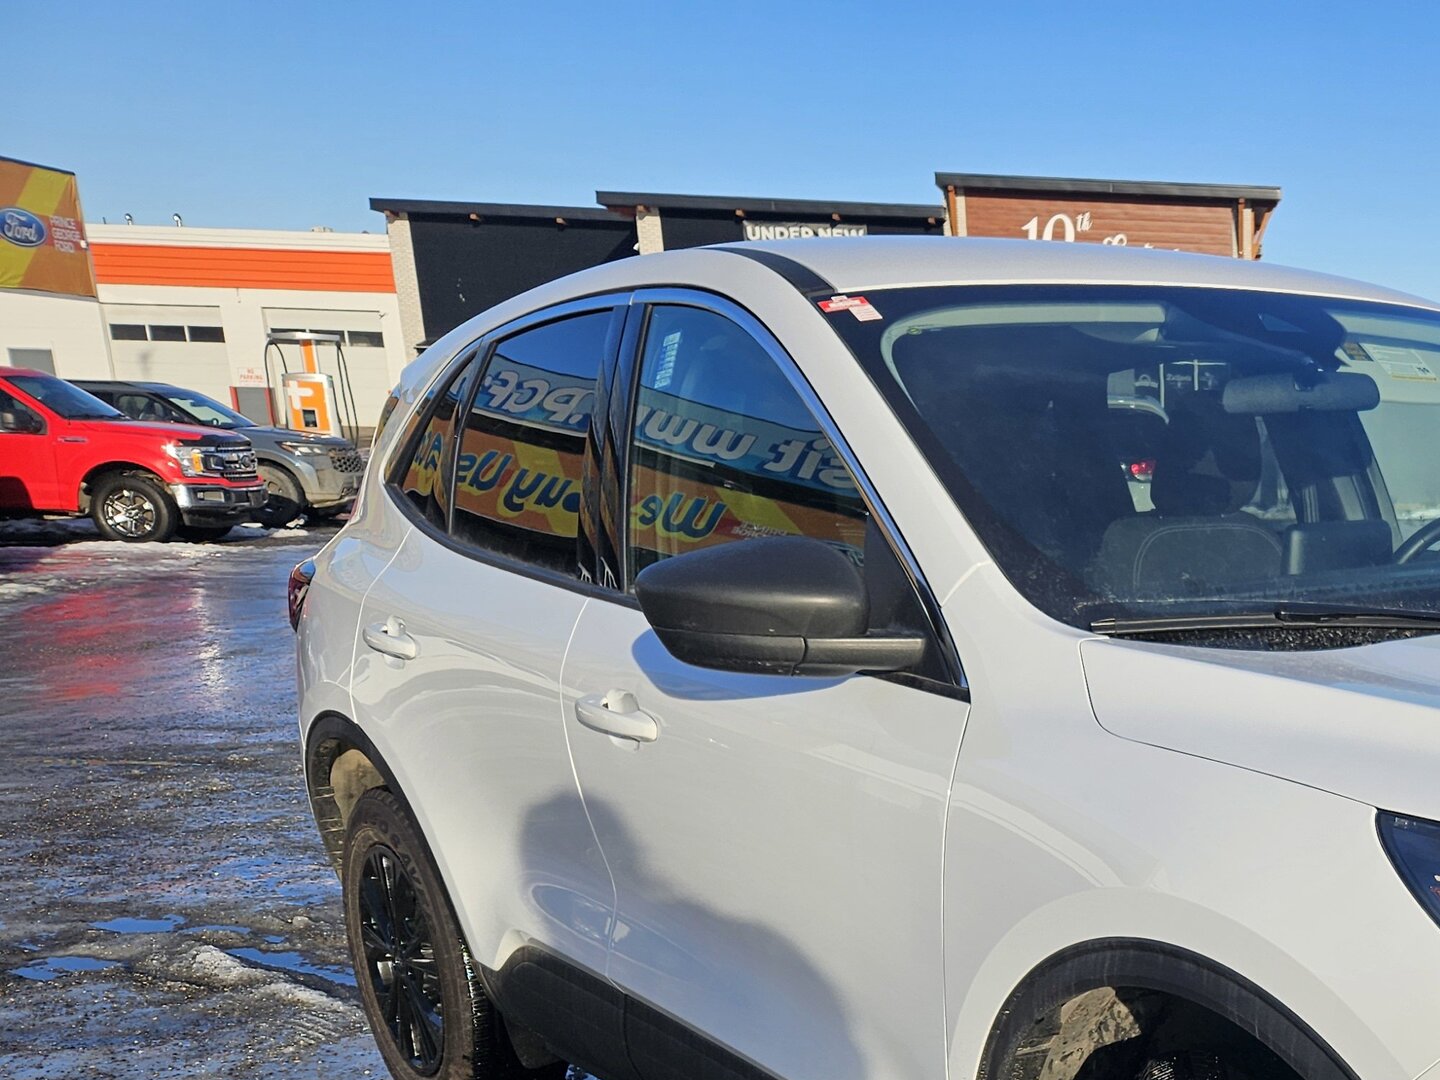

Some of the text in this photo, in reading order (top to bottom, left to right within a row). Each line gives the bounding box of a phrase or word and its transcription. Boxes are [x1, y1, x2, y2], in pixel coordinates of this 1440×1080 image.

[4, 212, 38, 241] Ford
[746, 225, 814, 240] UNDER
[1021, 211, 1093, 242] 10th
